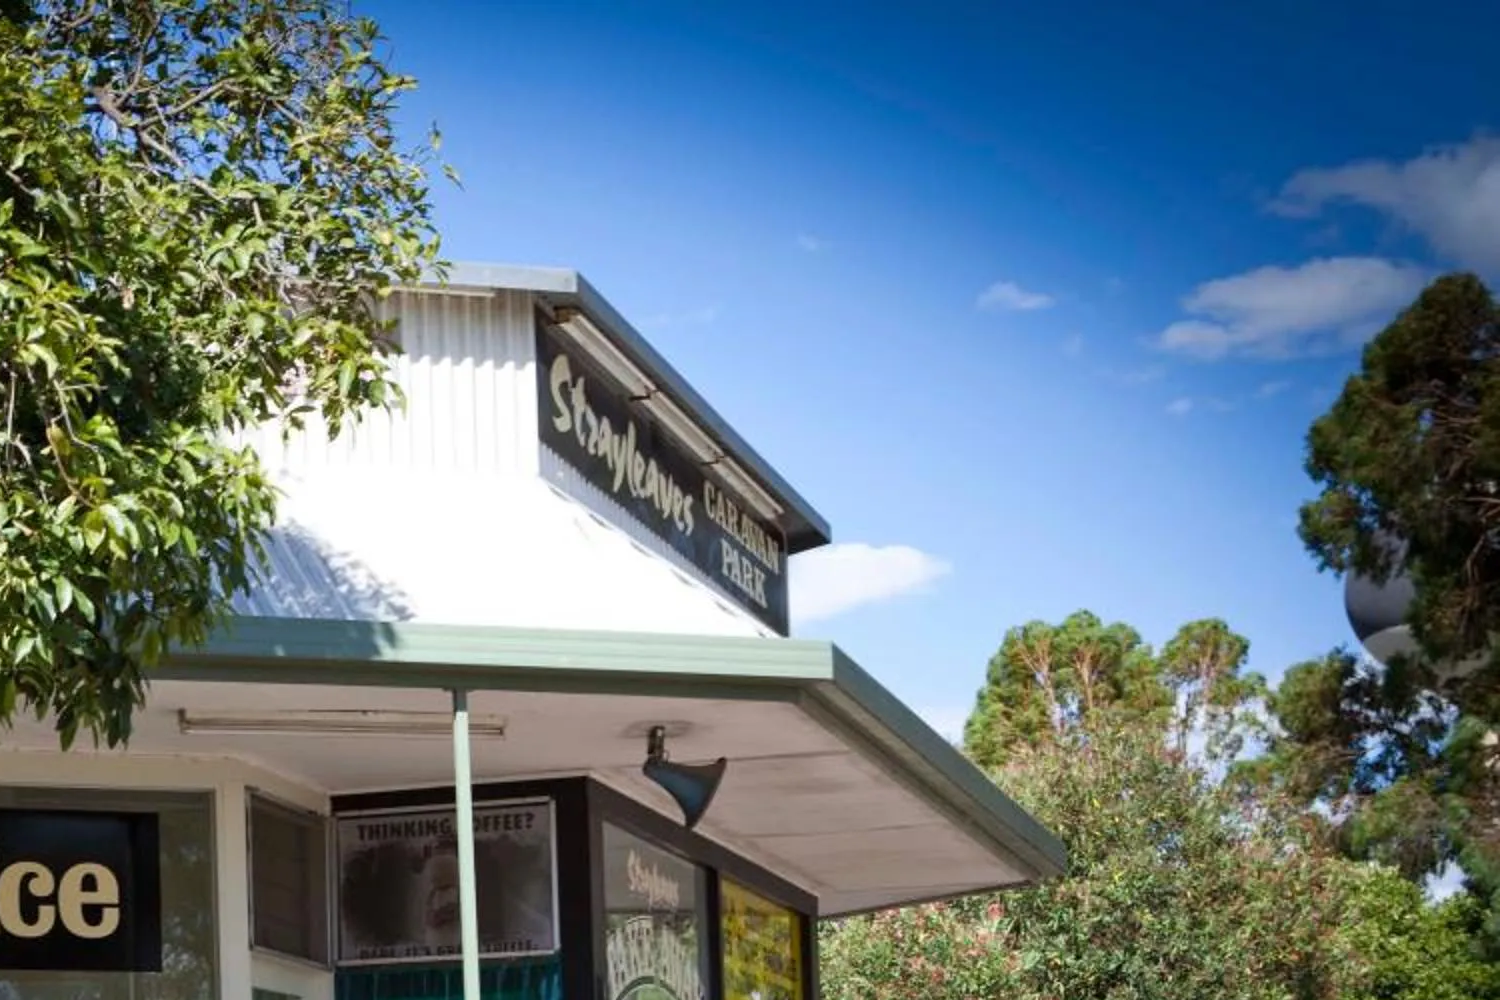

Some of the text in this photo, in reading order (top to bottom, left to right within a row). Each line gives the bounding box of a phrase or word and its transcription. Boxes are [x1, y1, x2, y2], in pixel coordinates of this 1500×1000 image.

[550, 353, 694, 536] Strayleaves
[703, 479, 780, 575] CARAVAN
[720, 537, 768, 608] PARK
[356, 812, 535, 842] THINKING OFFEE?
